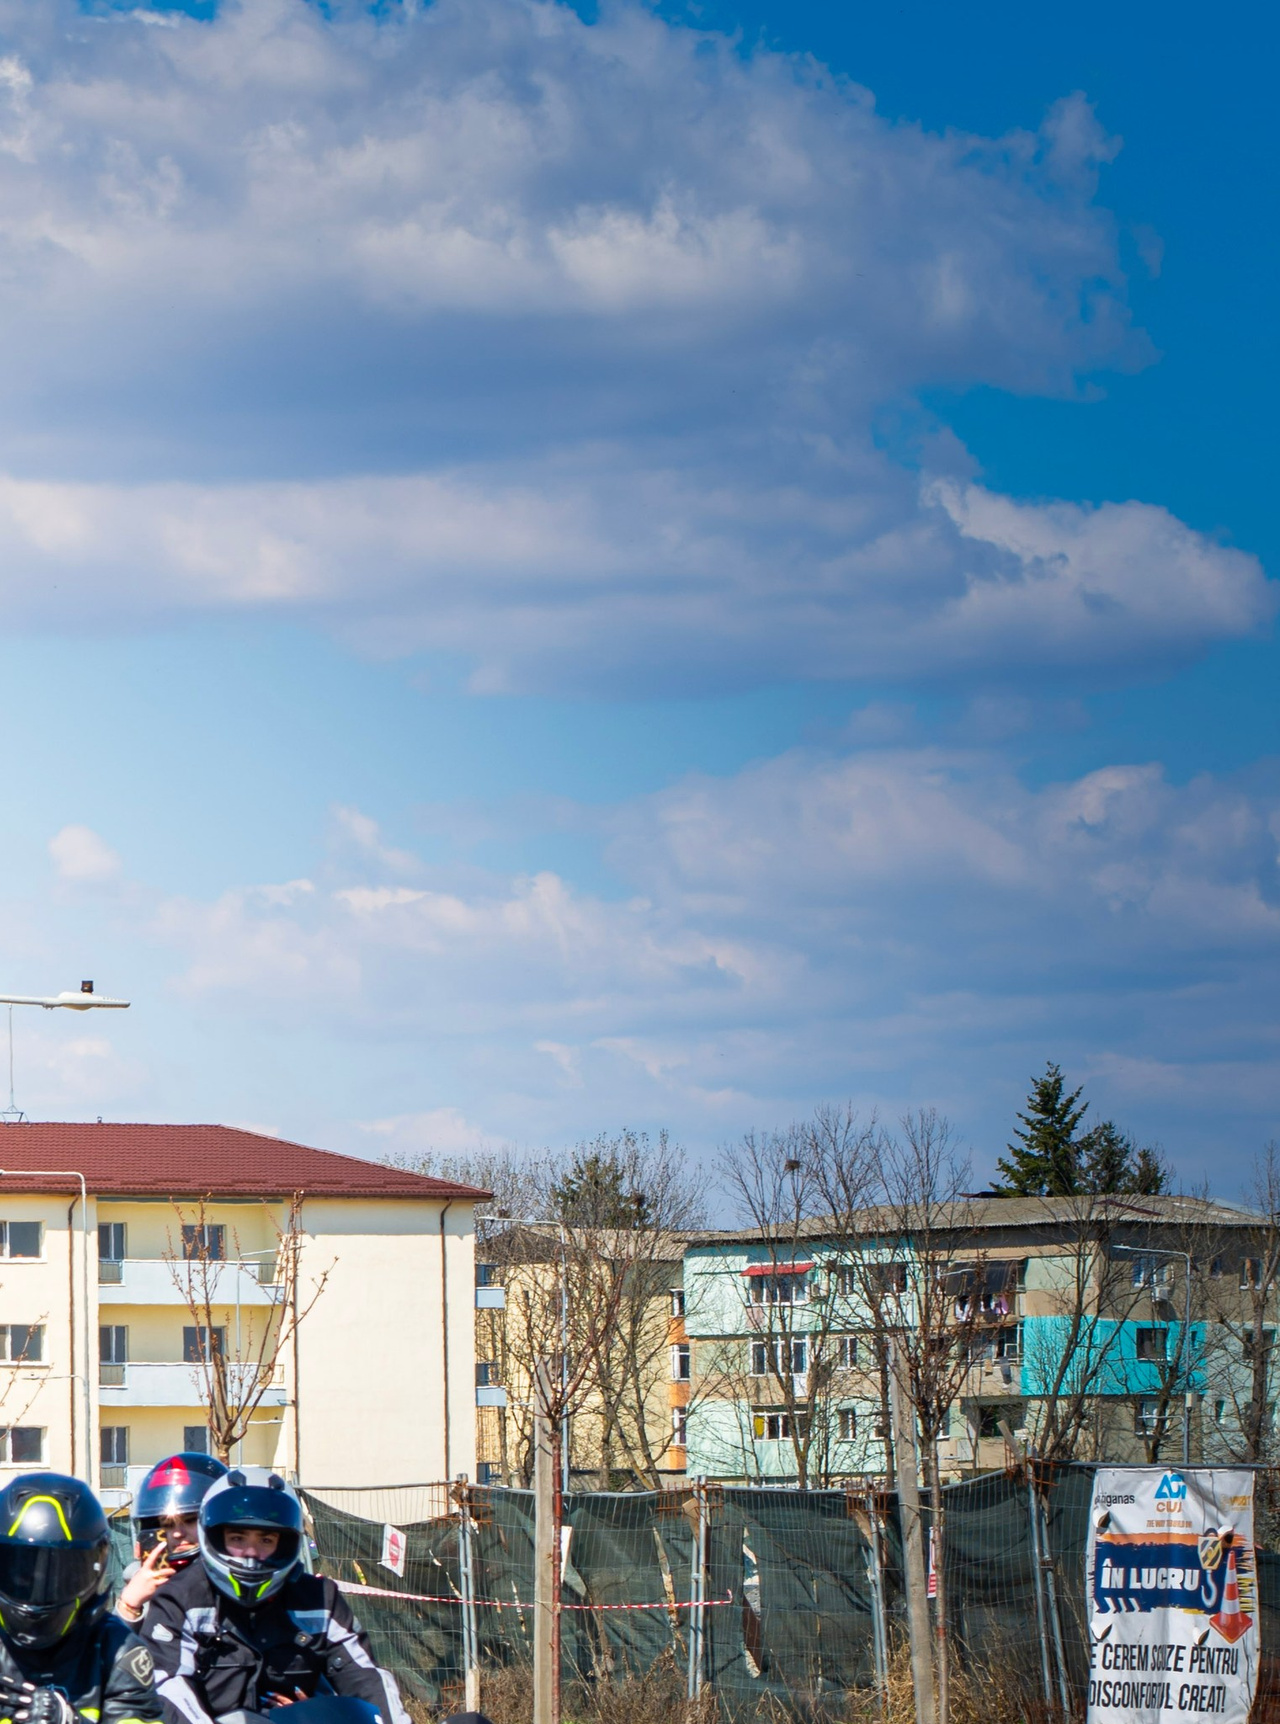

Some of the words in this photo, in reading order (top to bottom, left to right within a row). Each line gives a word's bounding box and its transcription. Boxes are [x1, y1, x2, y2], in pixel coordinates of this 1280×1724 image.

[1100, 1558, 1124, 1589] ÎN
[1129, 1567, 1200, 1591] LUCRU
[1102, 1643, 1148, 1671] CEREM
[1151, 1644, 1187, 1672] SCUZE
[1189, 1646, 1239, 1676] PENTRU
[1178, 1683, 1227, 1713] CREAT!
